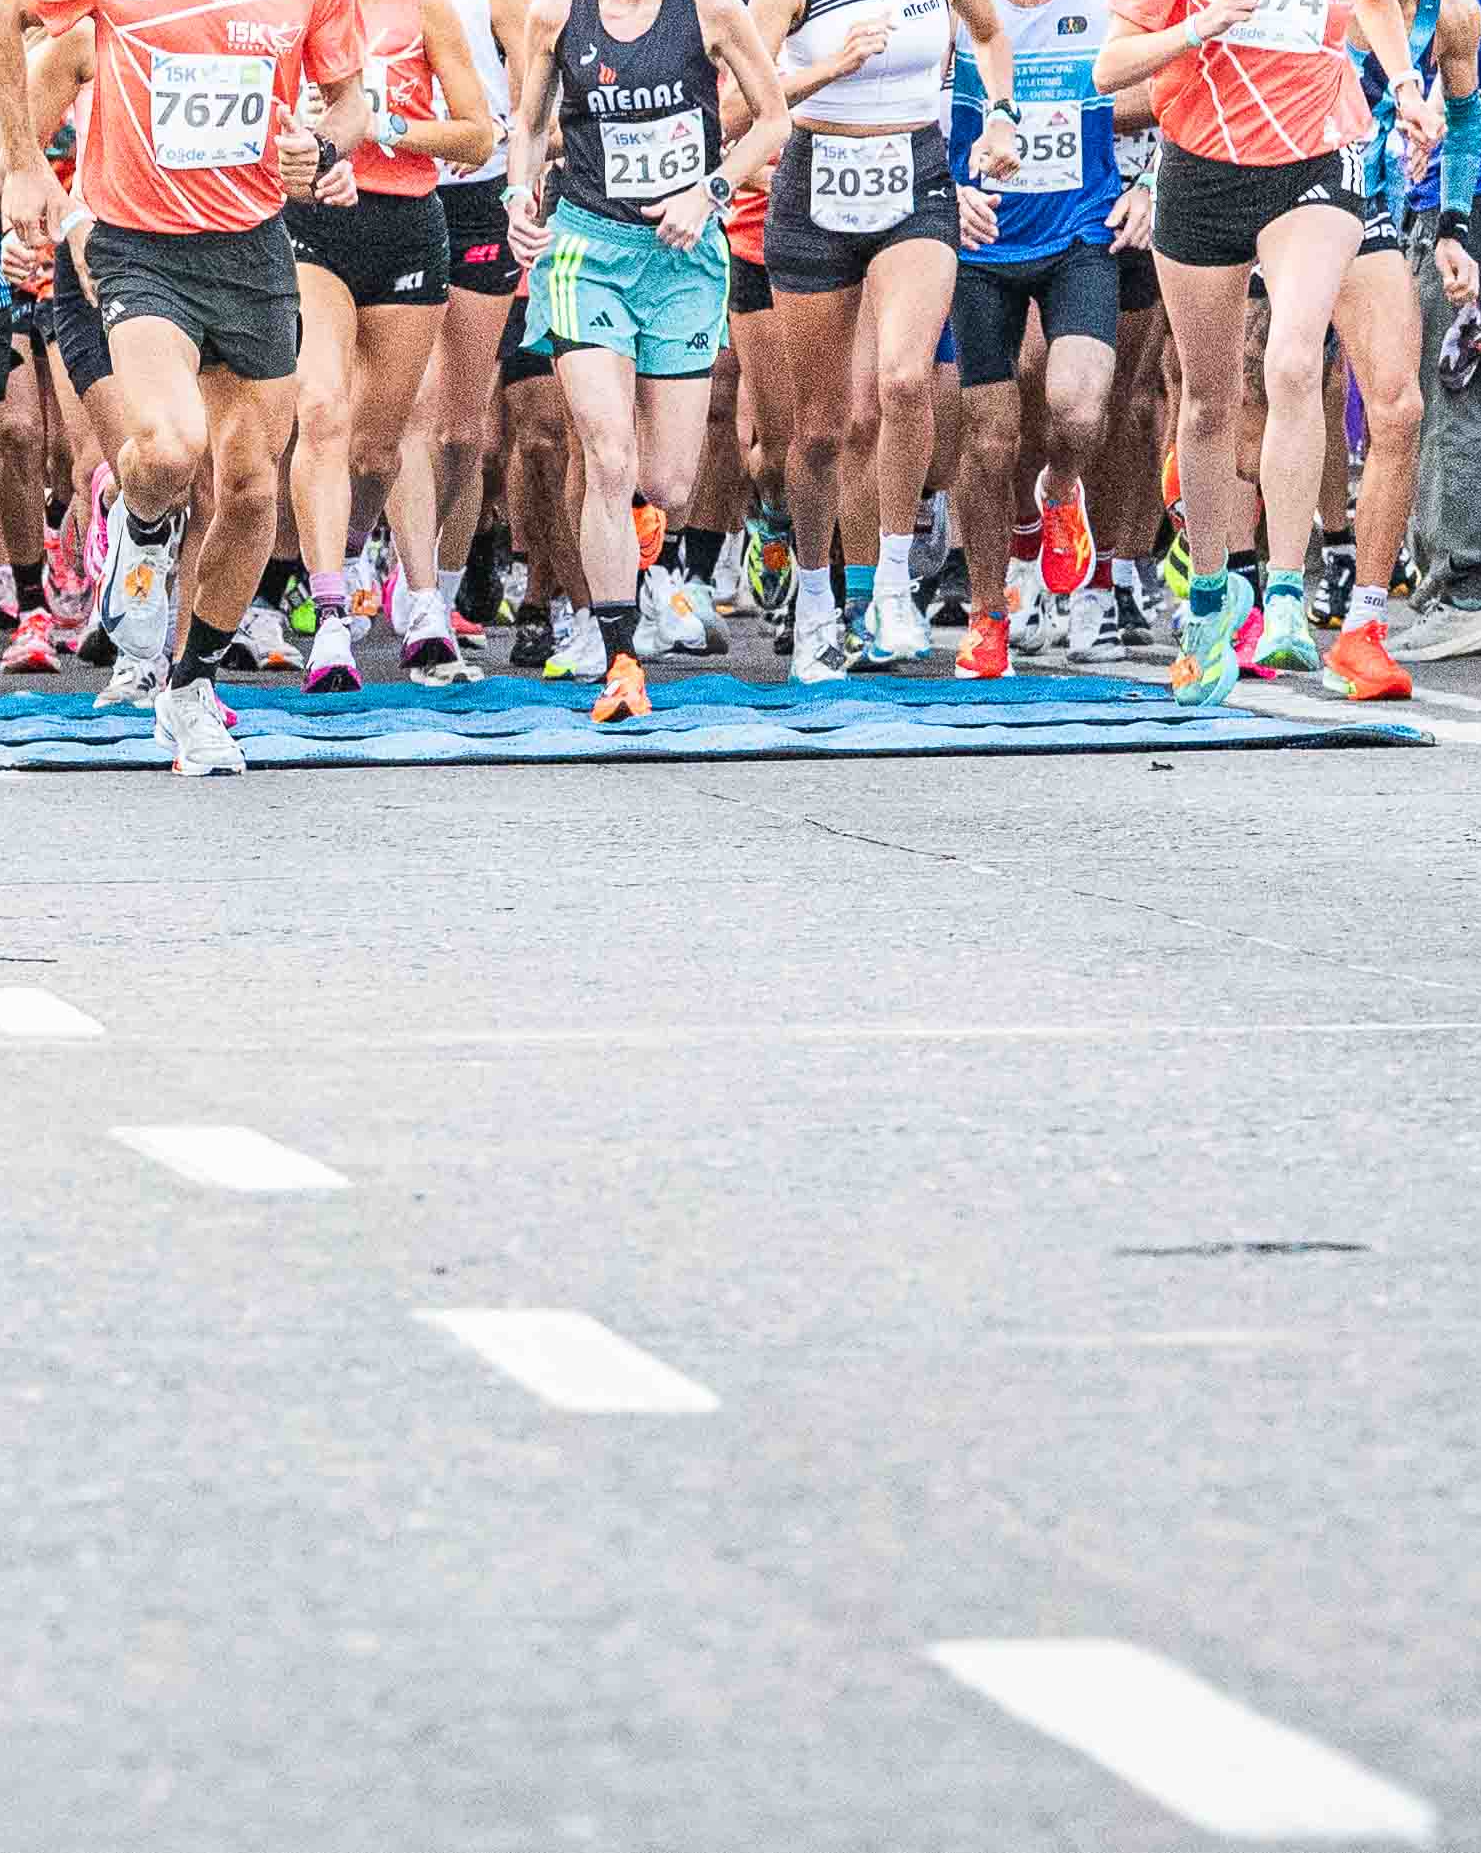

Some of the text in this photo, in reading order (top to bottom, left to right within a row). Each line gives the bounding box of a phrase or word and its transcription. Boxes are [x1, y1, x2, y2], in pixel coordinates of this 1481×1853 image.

[166, 67, 197, 83] 15K
[155, 91, 265, 128] 7670
[587, 80, 684, 113] ATENAS
[612, 132, 641, 146] 15K
[611, 143, 700, 184] 2163
[816, 165, 909, 197] 2038
